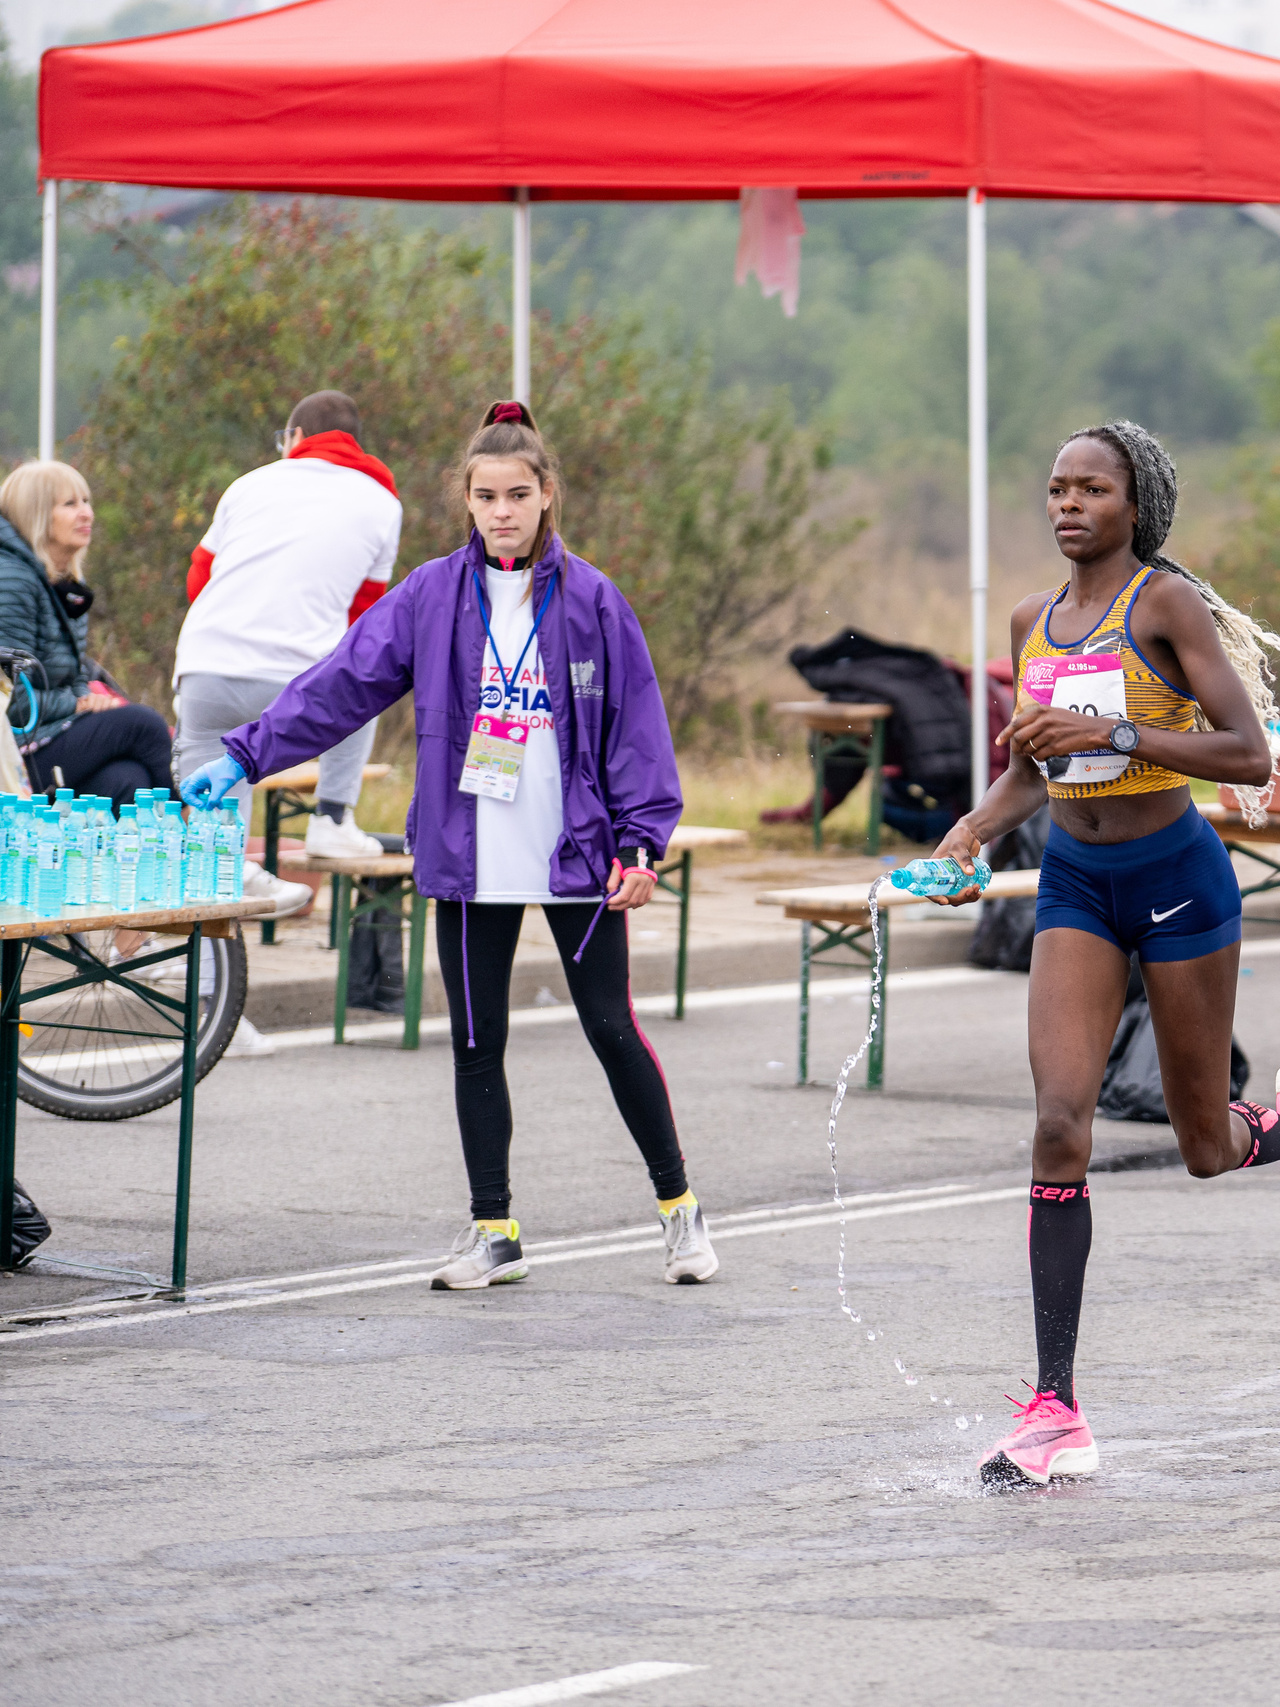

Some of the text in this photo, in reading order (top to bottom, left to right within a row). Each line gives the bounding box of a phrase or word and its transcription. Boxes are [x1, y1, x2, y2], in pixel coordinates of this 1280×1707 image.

[481, 666, 513, 682] IZZ
[1067, 663, 1088, 671] 42.195
[478, 685, 552, 712] OFIA
[1031, 1185, 1077, 1202] cep
